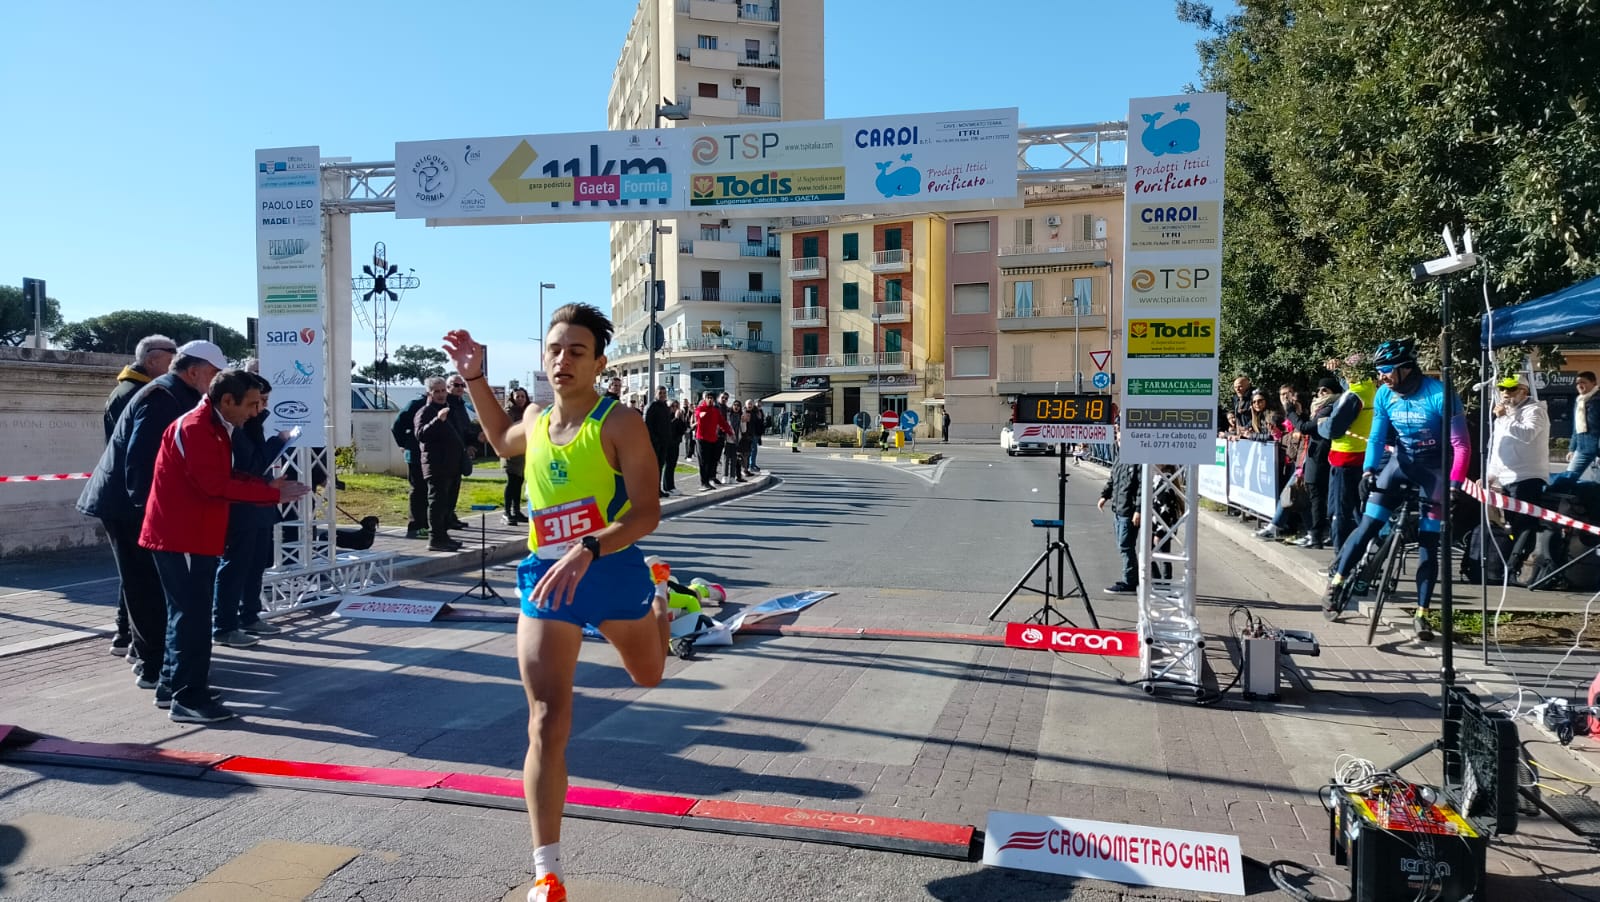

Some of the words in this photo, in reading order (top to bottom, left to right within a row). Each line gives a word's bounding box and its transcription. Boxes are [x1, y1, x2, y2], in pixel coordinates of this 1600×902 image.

[856, 126, 917, 149] CARDI
[958, 129, 980, 137] ITRI
[724, 132, 779, 160] TSP
[928, 164, 962, 178] Prodotti
[965, 160, 988, 173] Ittici
[1134, 161, 1178, 178] Prodotti
[1184, 156, 1210, 171] Ittici
[544, 178, 572, 189] podistica
[580, 181, 615, 195] Gaeta
[624, 178, 668, 194] Formia
[717, 171, 792, 198] Todis
[928, 174, 986, 193] Purificato
[1134, 172, 1207, 194] Purificato
[262, 200, 294, 210] PAOLO
[295, 199, 314, 209] LEO
[416, 192, 445, 202] FORMIA
[1141, 206, 1198, 223] CARDI
[1160, 268, 1210, 290] TSP
[1139, 296, 1208, 306] www.tspitalia.com
[266, 331, 298, 343] sara
[1150, 321, 1211, 338] Todis
[1144, 381, 1189, 389] FARMACIA
[1041, 425, 1107, 440] CRONOMETROGARA
[1130, 431, 1151, 439] Gaeta
[1198, 432, 1207, 440] 60
[1153, 441, 1170, 449] 0771
[1171, 441, 1197, 449] 470102
[544, 509, 592, 542] 315
[1048, 829, 1232, 875] CRONOMETROGARA
